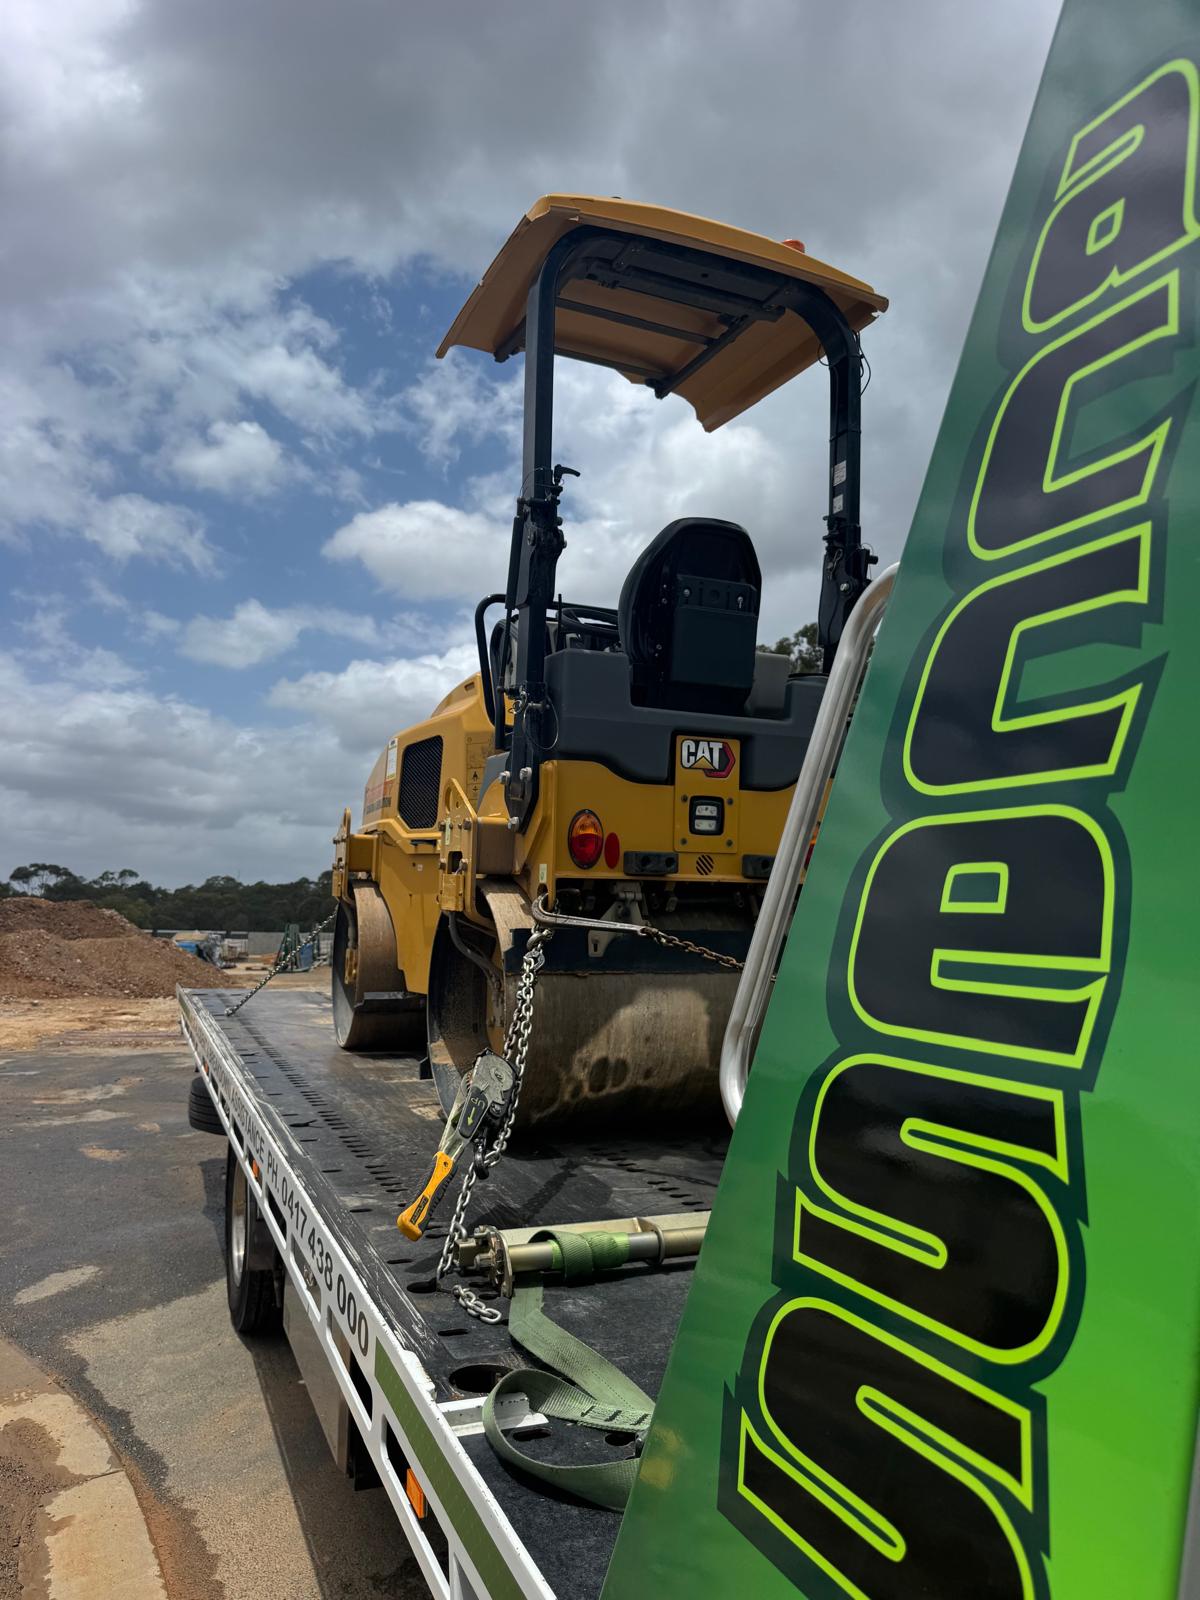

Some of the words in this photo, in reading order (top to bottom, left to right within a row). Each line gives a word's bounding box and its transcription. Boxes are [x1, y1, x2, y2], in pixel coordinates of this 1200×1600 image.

[681, 739, 723, 770] CAT
[470, 1097, 486, 1109] UP
[267, 1149, 280, 1193] PH.
[281, 1176, 308, 1239] 0417
[307, 1227, 334, 1292] 438
[336, 1273, 369, 1357] 000
